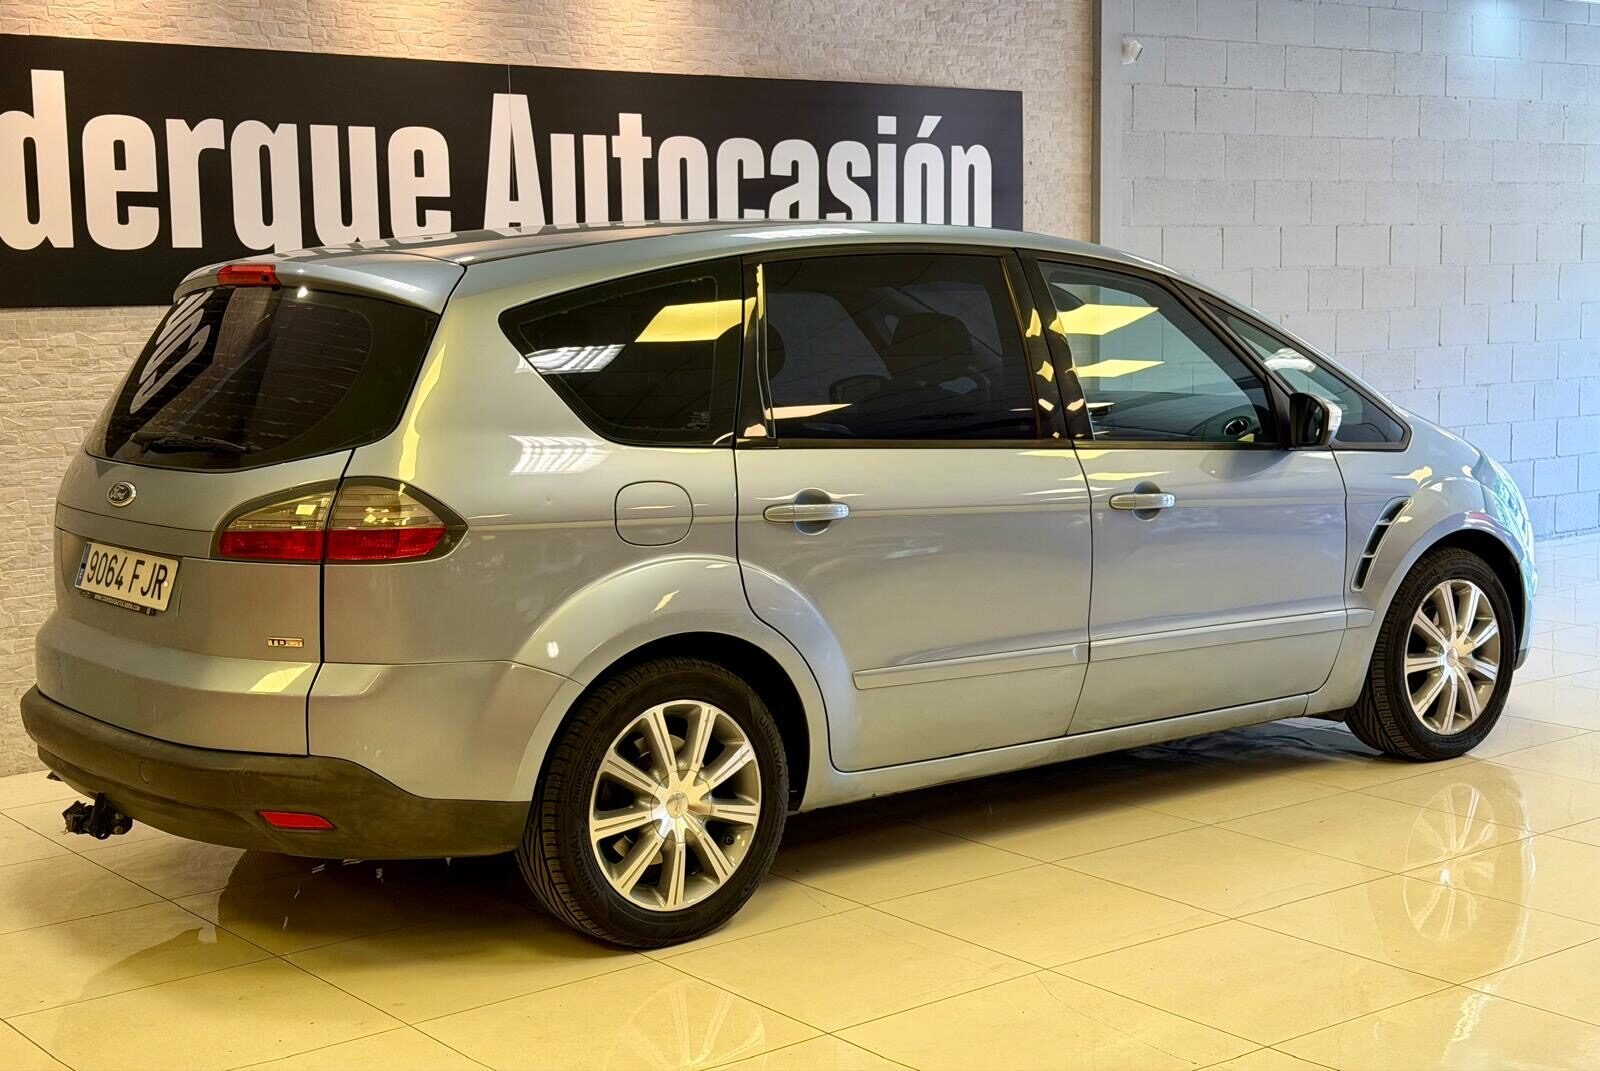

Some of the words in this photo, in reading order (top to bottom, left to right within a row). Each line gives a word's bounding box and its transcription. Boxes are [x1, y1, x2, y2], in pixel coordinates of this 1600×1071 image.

[0, 69, 451, 254] derque
[483, 93, 993, 230] Autocasión
[87, 550, 129, 591] 9064
[128, 559, 168, 601] FJR
[567, 829, 600, 901] UNIROYAL
